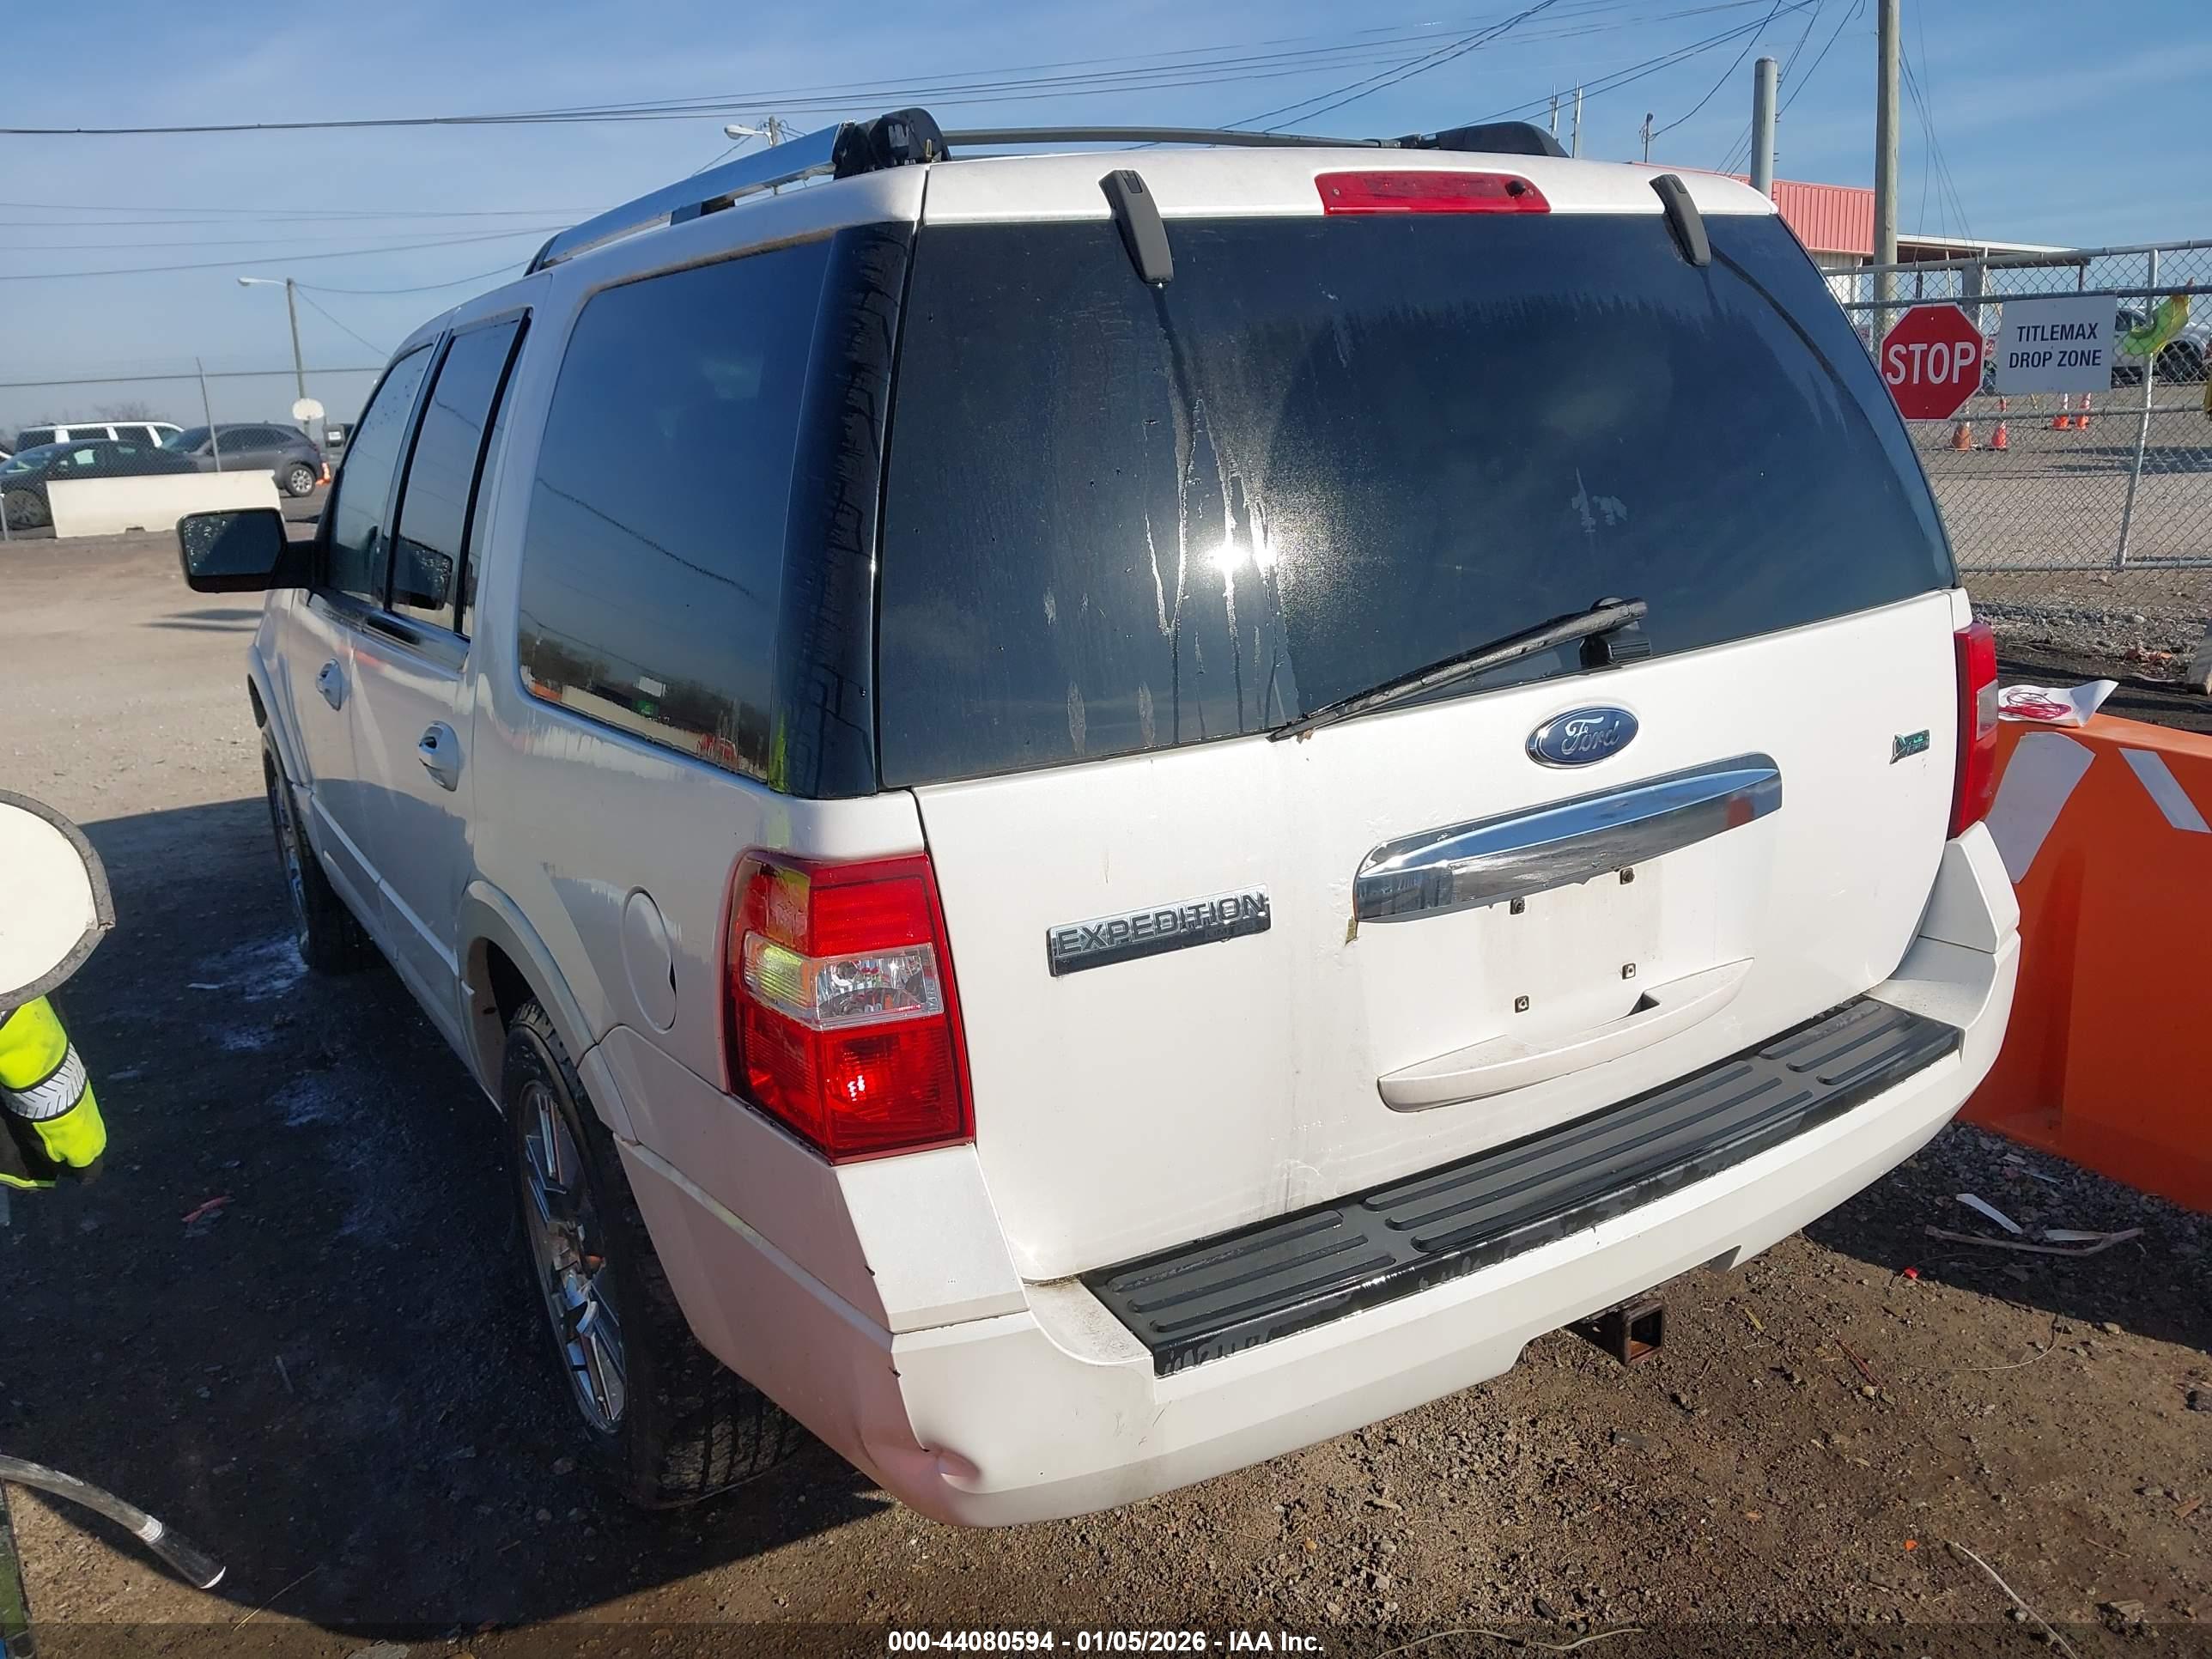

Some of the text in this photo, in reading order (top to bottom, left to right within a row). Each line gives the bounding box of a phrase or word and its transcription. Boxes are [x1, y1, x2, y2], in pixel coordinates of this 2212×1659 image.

[2016, 322, 2099, 343] TITLEMAX
[1886, 341, 1976, 385] STOP
[2008, 349, 2102, 369] DROP ZONE
[1560, 715, 1621, 756] Ford
[1055, 890, 1267, 957] EXPEDITION
